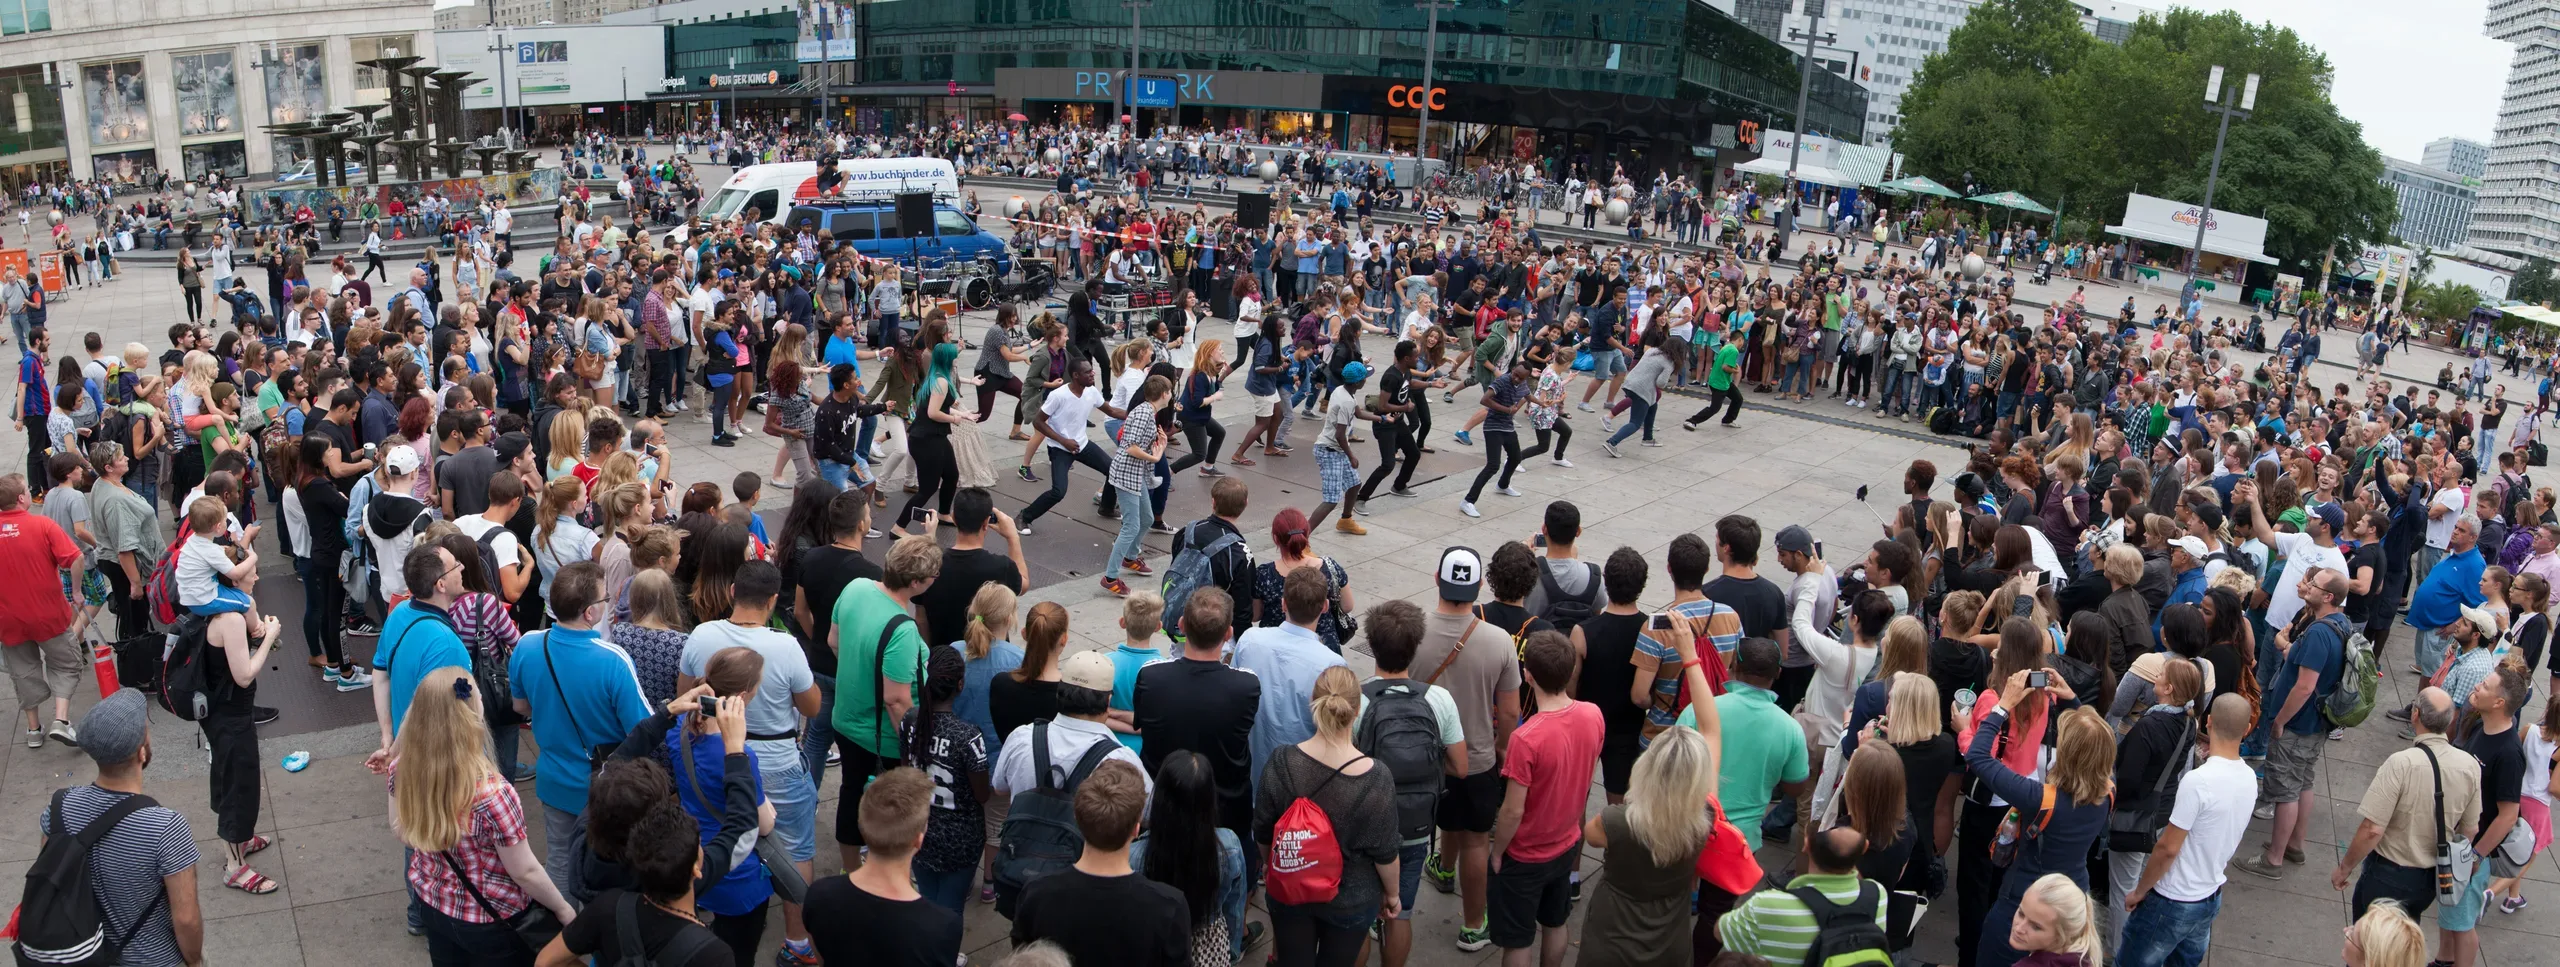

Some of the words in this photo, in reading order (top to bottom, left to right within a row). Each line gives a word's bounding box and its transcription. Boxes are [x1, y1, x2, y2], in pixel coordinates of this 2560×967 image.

[523, 48, 533, 61] P
[718, 74, 748, 86] BURGER
[747, 72, 768, 84] KING
[1146, 80, 1156, 95] U
[1387, 84, 1447, 111] CCC
[1739, 120, 1759, 145] CCC
[1283, 831, 1292, 840] ES
[1283, 841, 1303, 849] STILL
[1279, 850, 1299, 858] PLAY
